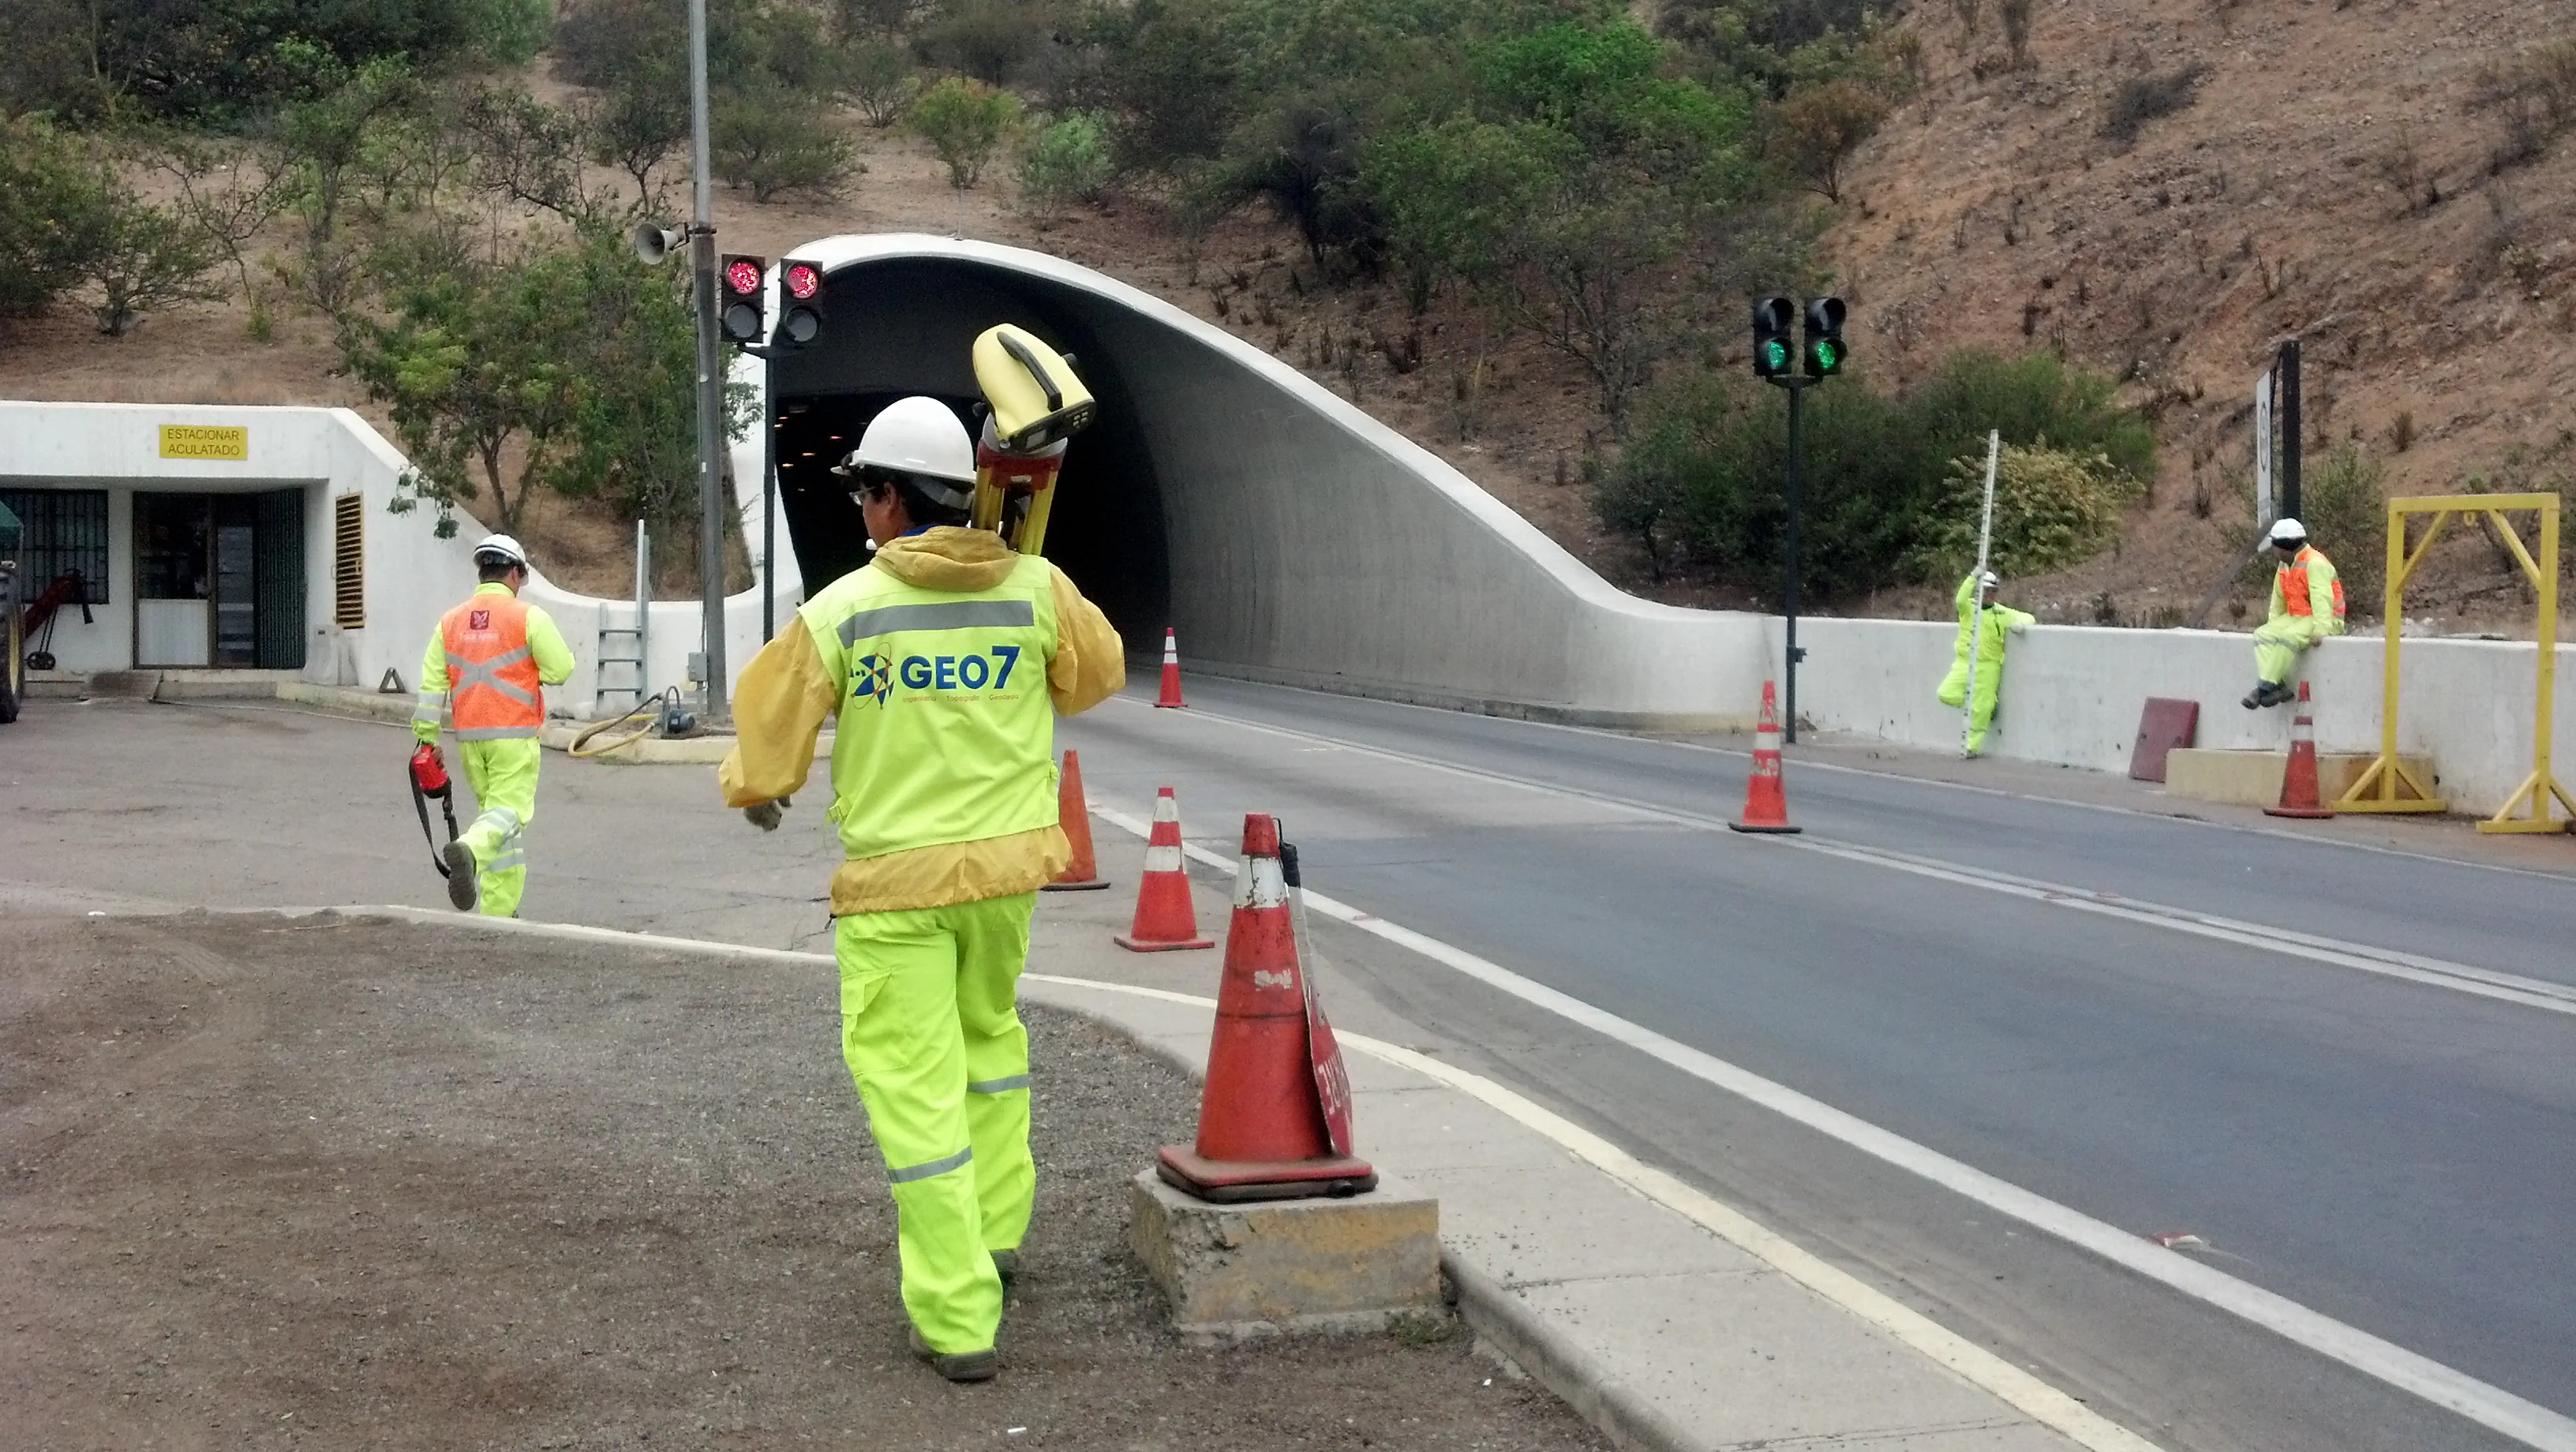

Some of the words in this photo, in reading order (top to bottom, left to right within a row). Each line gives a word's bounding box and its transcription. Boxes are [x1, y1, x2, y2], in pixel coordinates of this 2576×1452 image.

[167, 428, 239, 440] ESTACIONAR
[168, 443, 240, 455] ACULATADO
[900, 646, 1020, 690] GEO7
